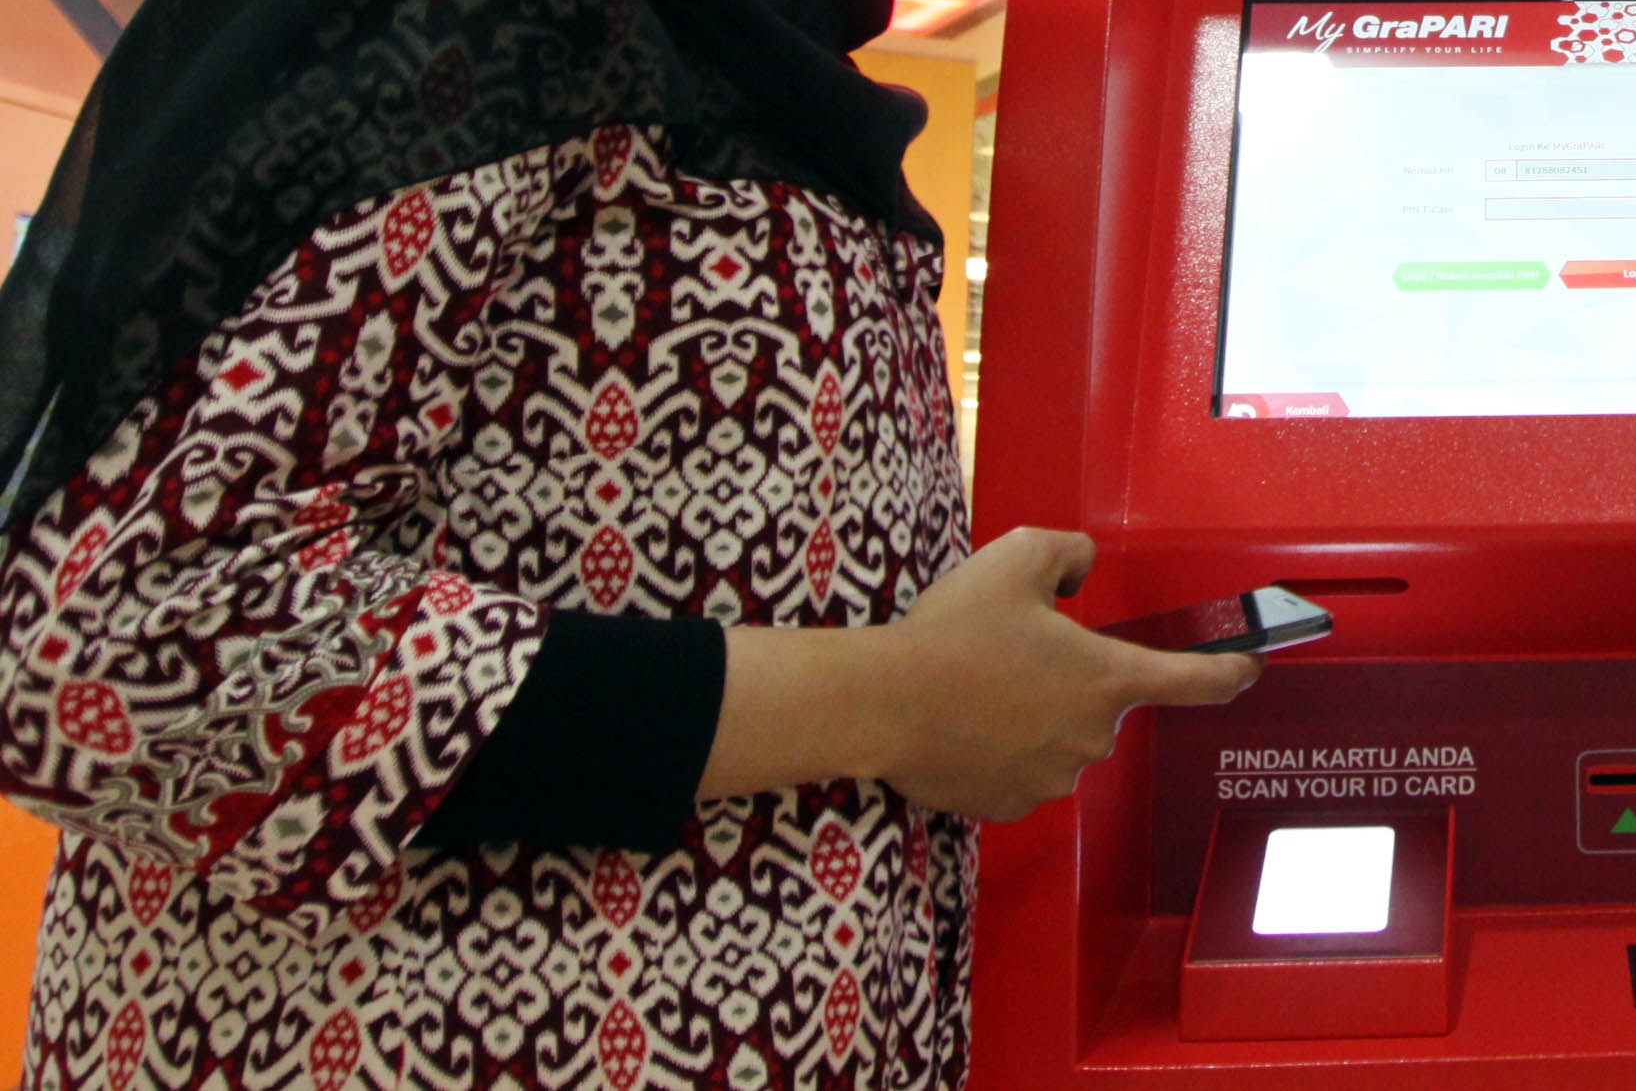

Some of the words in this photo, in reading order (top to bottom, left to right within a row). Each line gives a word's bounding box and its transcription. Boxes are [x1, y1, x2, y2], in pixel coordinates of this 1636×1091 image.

[1286, 11, 1346, 55] My
[1353, 14, 1510, 39] GraPARI
[1346, 46, 1417, 54] SIMPLIFY
[1425, 46, 1462, 54] YOUR
[1471, 46, 1503, 54] LIFE
[1508, 142, 1536, 152] Login
[1285, 405, 1330, 416] Kembali
[1220, 750, 1305, 770] PINDAI
[1312, 748, 1397, 768] KARTU
[1403, 746, 1475, 767] ANDA
[1218, 779, 1288, 799] SCAN
[1295, 777, 1366, 798] YOUR
[1373, 777, 1398, 797] ID
[1404, 775, 1476, 796] CARD
